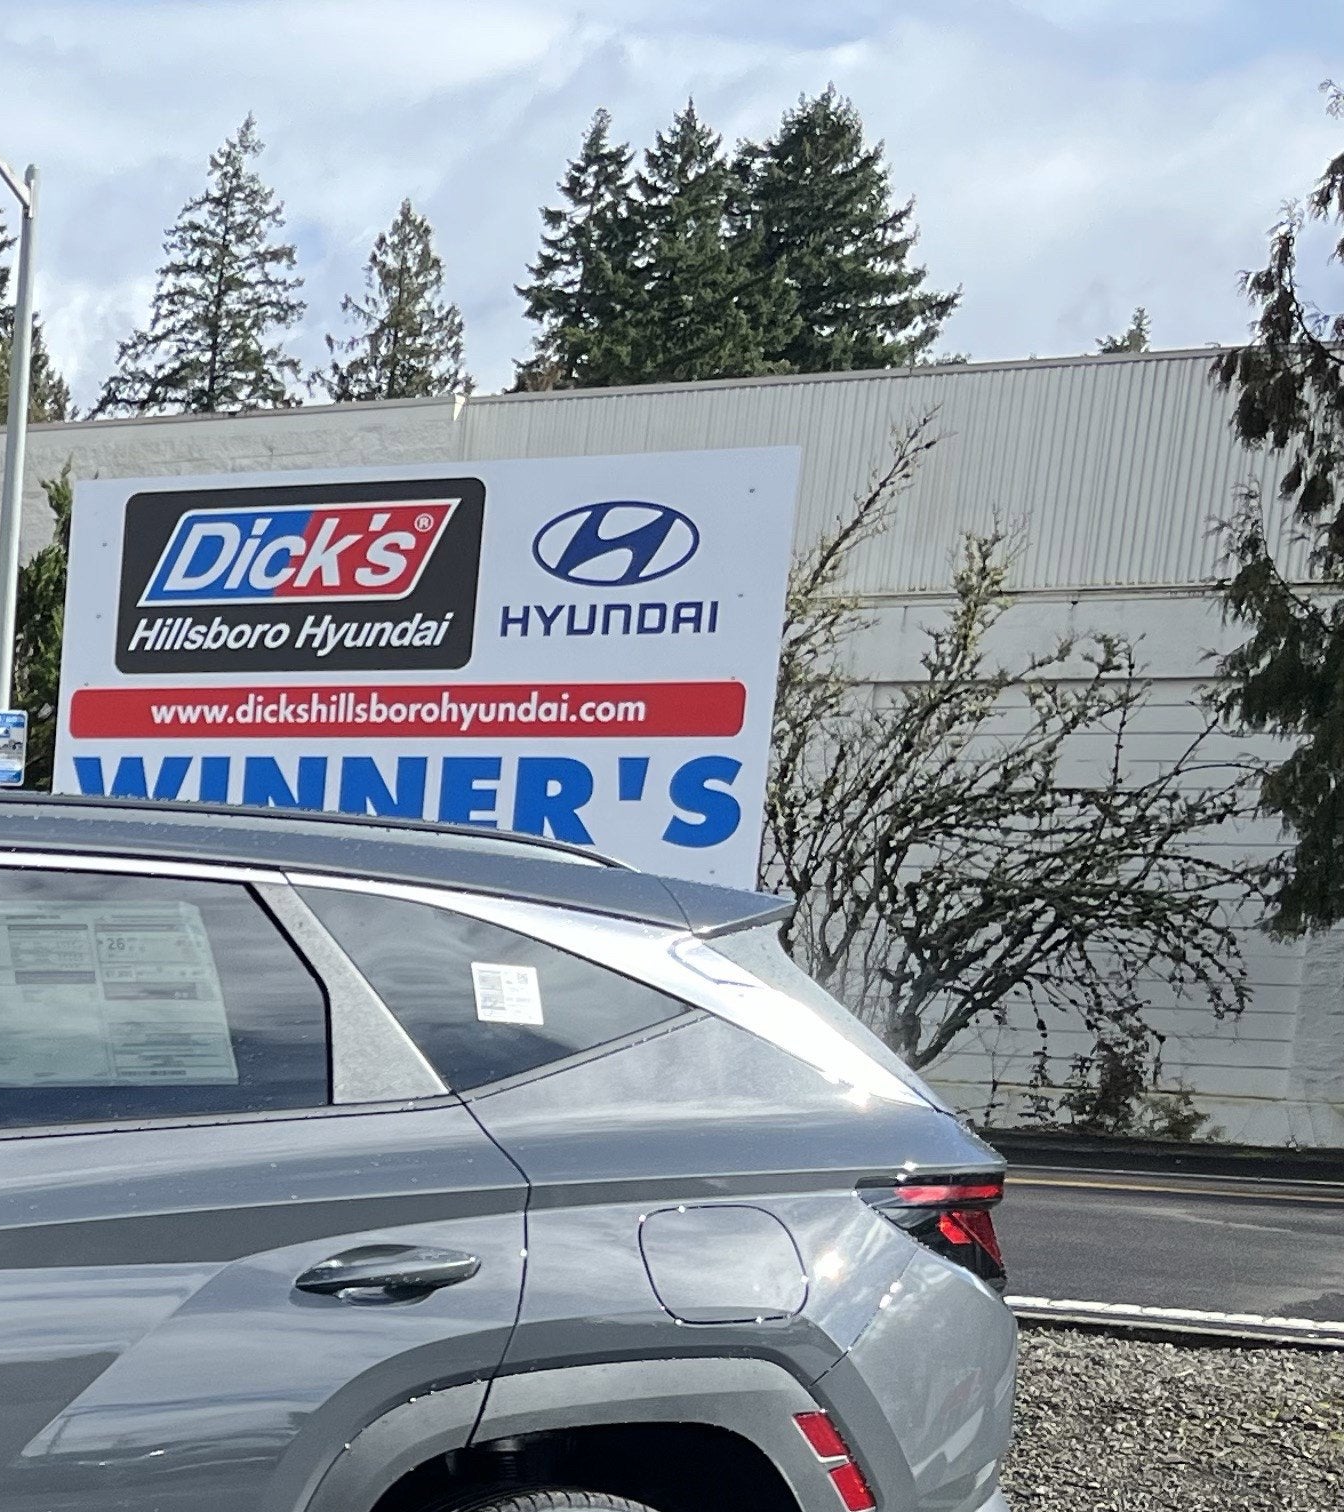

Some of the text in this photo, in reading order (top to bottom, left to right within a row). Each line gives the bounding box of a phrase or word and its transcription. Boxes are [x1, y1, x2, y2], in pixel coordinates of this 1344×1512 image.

[162, 513, 416, 591] Dick's
[127, 612, 454, 656] Hillsboro Hyundai
[500, 600, 719, 637] HYUNDAI
[151, 691, 646, 731] www.dickshillsborohyundai.com
[108, 937, 126, 951] 26
